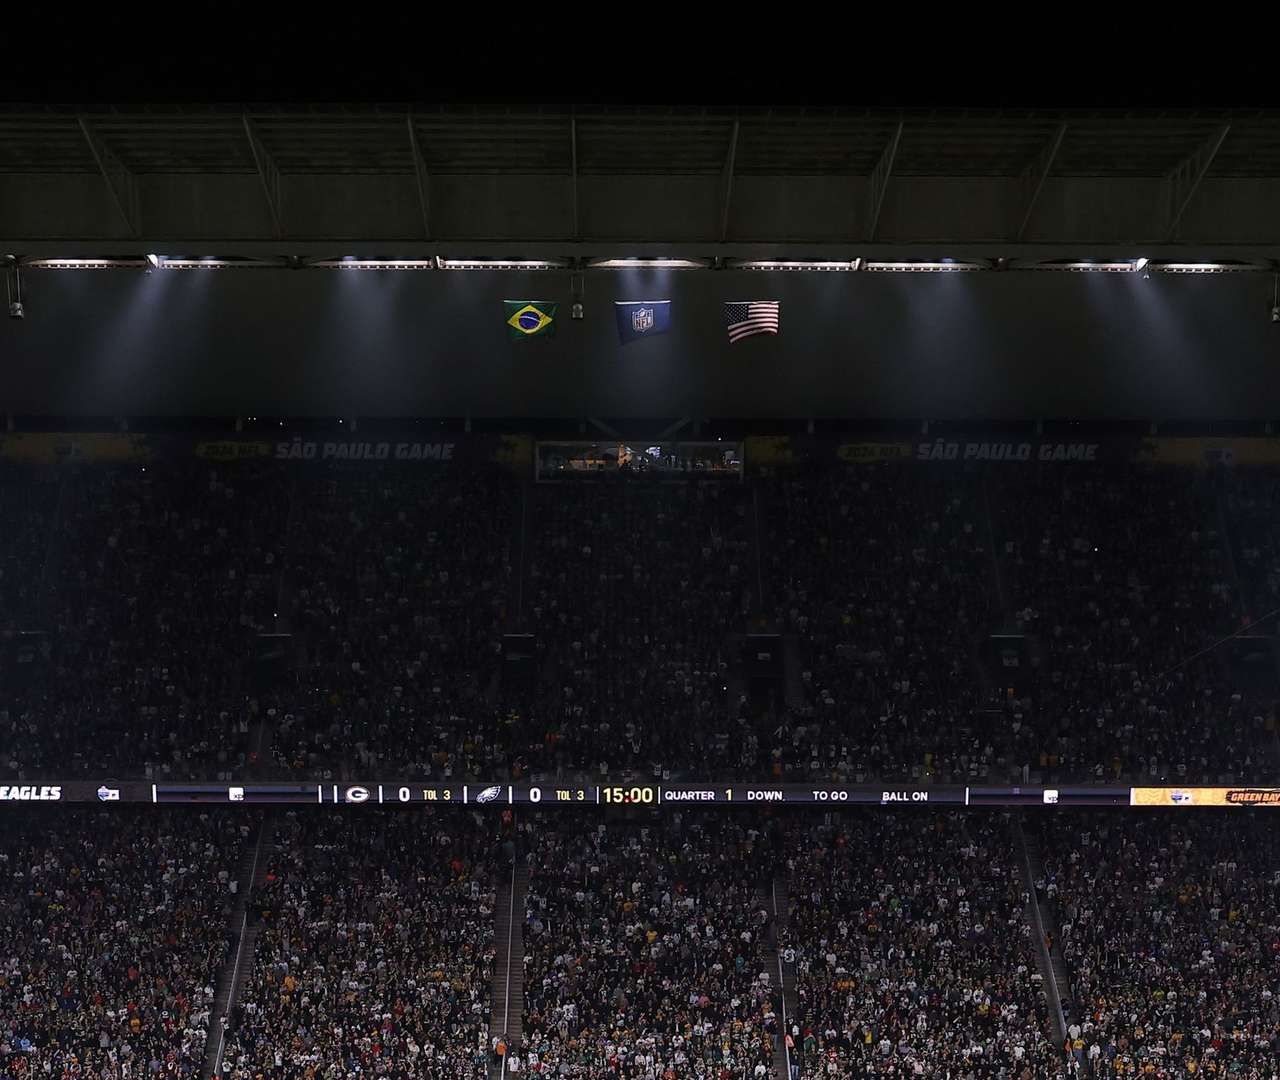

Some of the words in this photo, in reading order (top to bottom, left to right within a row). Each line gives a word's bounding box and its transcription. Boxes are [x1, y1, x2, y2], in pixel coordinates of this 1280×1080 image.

[275, 436, 317, 460] SÃO
[322, 442, 389, 460] PAULO
[395, 442, 456, 460] GAME
[917, 437, 959, 460] SÃO
[964, 443, 1032, 460] PAULO
[1039, 443, 1099, 461] GAME
[398, 787, 411, 802] 0
[443, 790, 451, 801] 3
[529, 788, 541, 802] 0
[577, 790, 585, 801] 3
[603, 787, 653, 803] 15:00
[665, 791, 715, 801] QUARTER
[725, 789, 732, 801] 1
[747, 791, 783, 801] DOWN
[813, 791, 828, 801] TO
[830, 791, 848, 801] GO
[882, 792, 909, 801] BALL
[912, 792, 929, 802] ON
[1231, 792, 1262, 802] GREEN
[1263, 792, 1280, 802] BAY
